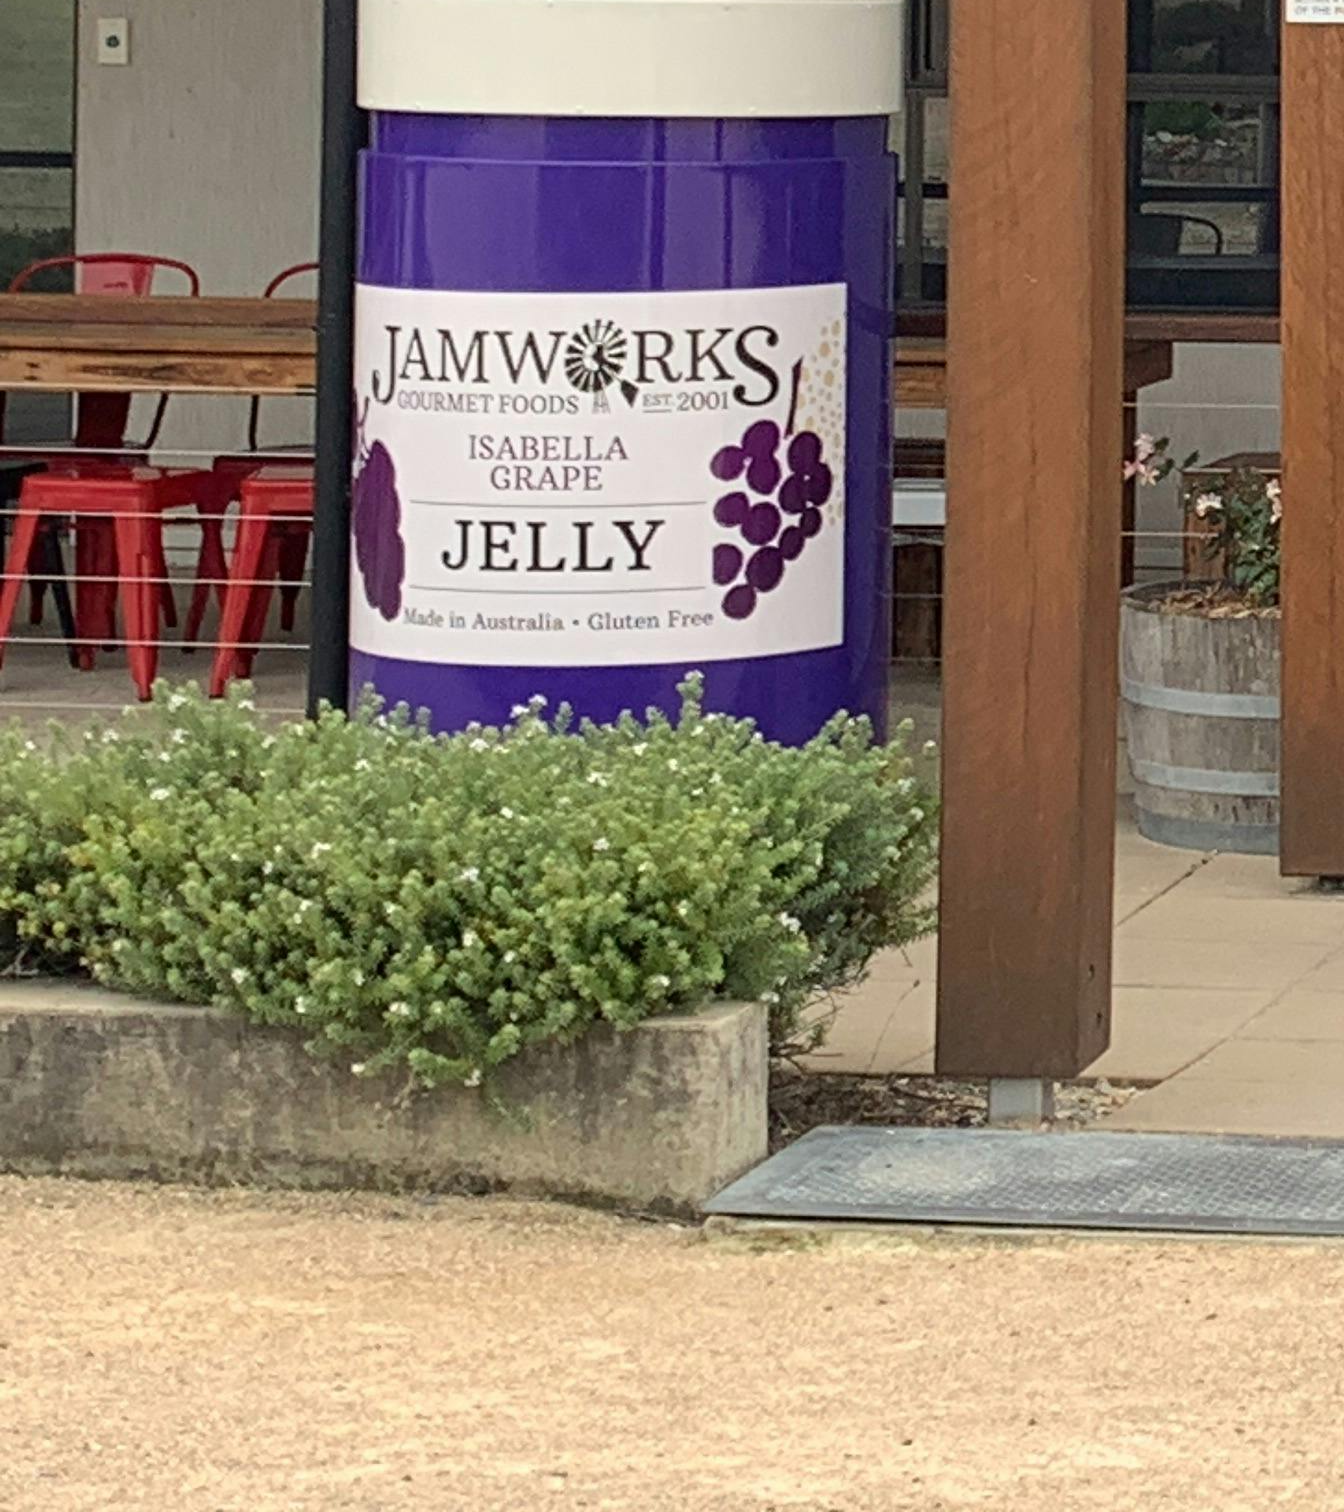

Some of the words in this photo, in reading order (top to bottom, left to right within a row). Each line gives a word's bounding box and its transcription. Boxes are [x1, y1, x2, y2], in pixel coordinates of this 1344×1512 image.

[397, 390, 494, 413] GOURMET
[498, 394, 580, 415] FOODS
[676, 391, 728, 412] 2001
[468, 434, 628, 462] ISABELLA
[490, 465, 603, 491] GRAPE
[441, 519, 665, 573] JELLY
[403, 608, 443, 628] Made
[448, 609, 467, 629] in
[471, 611, 565, 632] Australia
[587, 609, 660, 631] Gluten
[667, 608, 714, 629] Free
